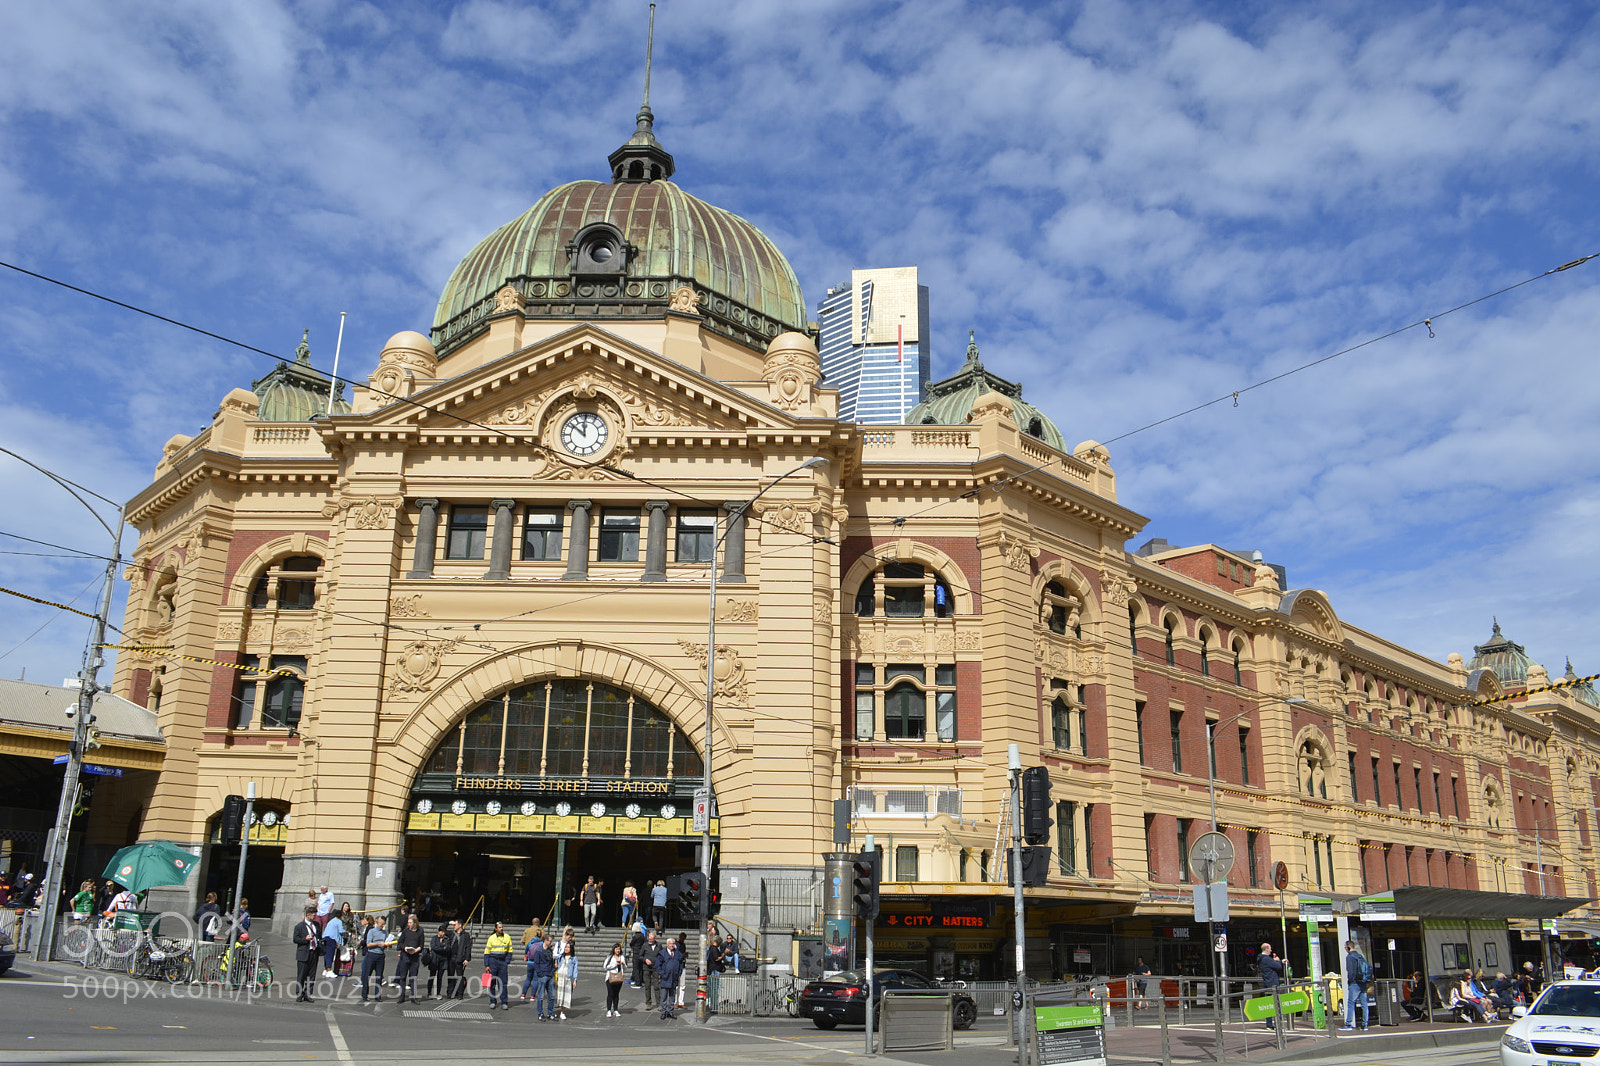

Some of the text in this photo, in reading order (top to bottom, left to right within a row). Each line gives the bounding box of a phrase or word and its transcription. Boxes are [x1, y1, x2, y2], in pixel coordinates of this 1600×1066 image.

[455, 777, 668, 793] FLINDERS STREET STATION
[904, 916, 984, 927] CITY HATTERS
